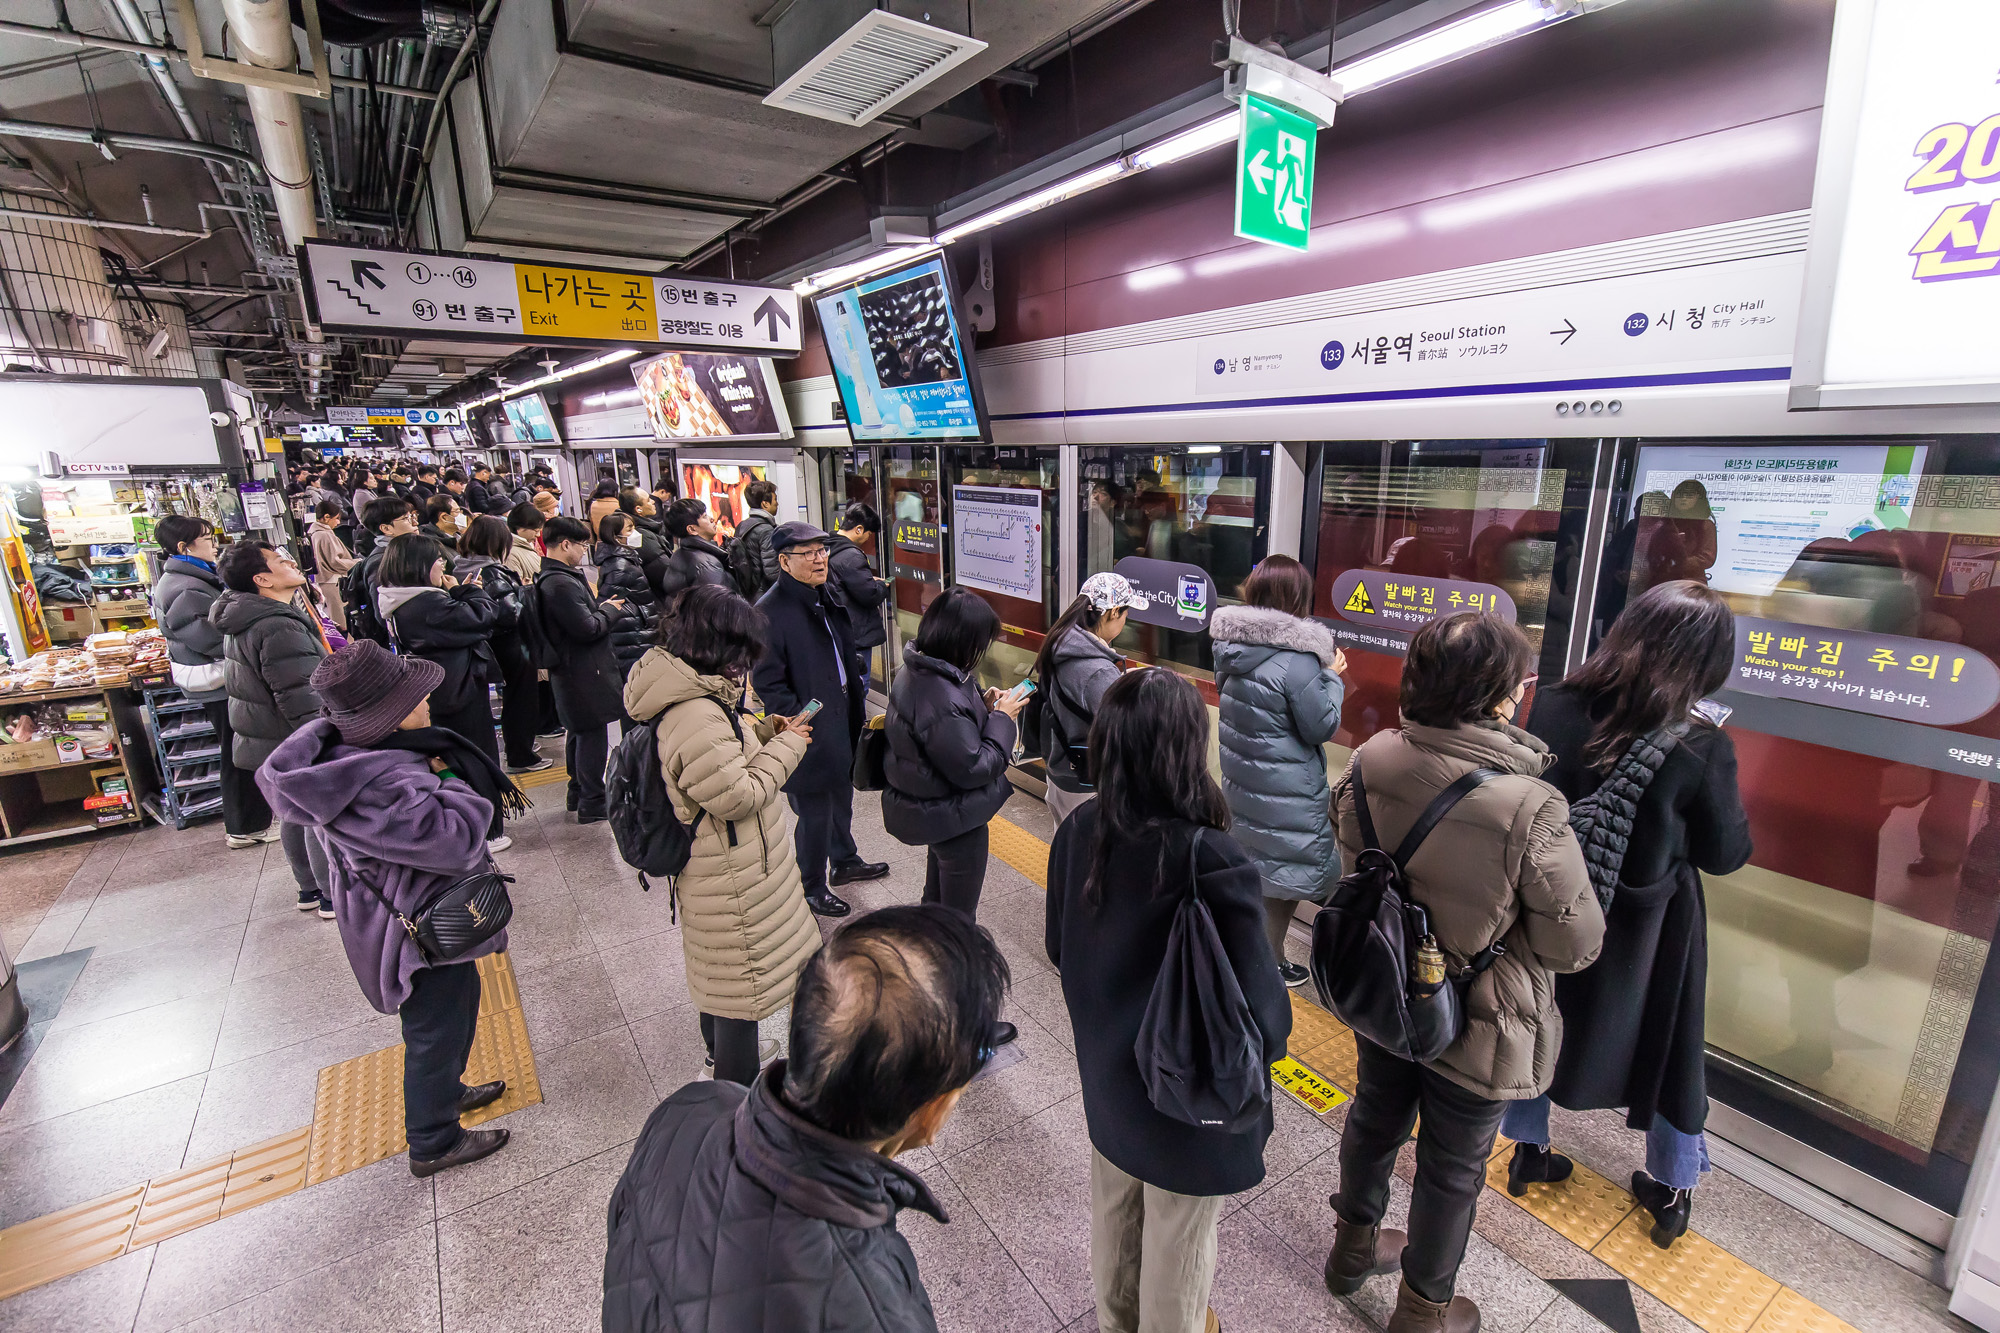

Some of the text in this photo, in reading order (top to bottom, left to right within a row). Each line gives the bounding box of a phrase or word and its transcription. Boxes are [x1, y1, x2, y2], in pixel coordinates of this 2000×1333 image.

[524, 271, 648, 312] 나가는 곳
[703, 290, 738, 308] 출구
[444, 303, 467, 321] 번
[474, 305, 517, 324] 출구
[1712, 299, 1765, 315] City Hall
[529, 310, 560, 326] Exit
[621, 317, 648, 331] 出口
[660, 318, 744, 339] 공항철도 이용
[1419, 324, 1507, 343] Seoul Station
[1350, 332, 1414, 365] 서울역
[1458, 342, 1509, 358] ソウルヨク
[1253, 353, 1283, 363] Namyeong
[70, 464, 126, 472] CCTV 녹화중
[1145, 590, 1158, 602] the
[1158, 590, 1178, 607] City
[1383, 600, 1403, 609] Watch
[1403, 603, 1418, 611] your
[1419, 606, 1433, 614] step
[1381, 608, 1402, 620] 열차와
[1403, 611, 1425, 623] 승강장
[1336, 629, 1359, 642] 승하차는
[1359, 633, 1388, 647] 안전사고를
[1744, 654, 1779, 668] Watch
[1781, 661, 1809, 673] your
[1810, 666, 1837, 678] step
[1739, 665, 1931, 709] 열차와 승강장 사이가 넓습니다.
[1948, 748, 1994, 767] 약냉방
[1292, 1068, 1336, 1100] 열차와
